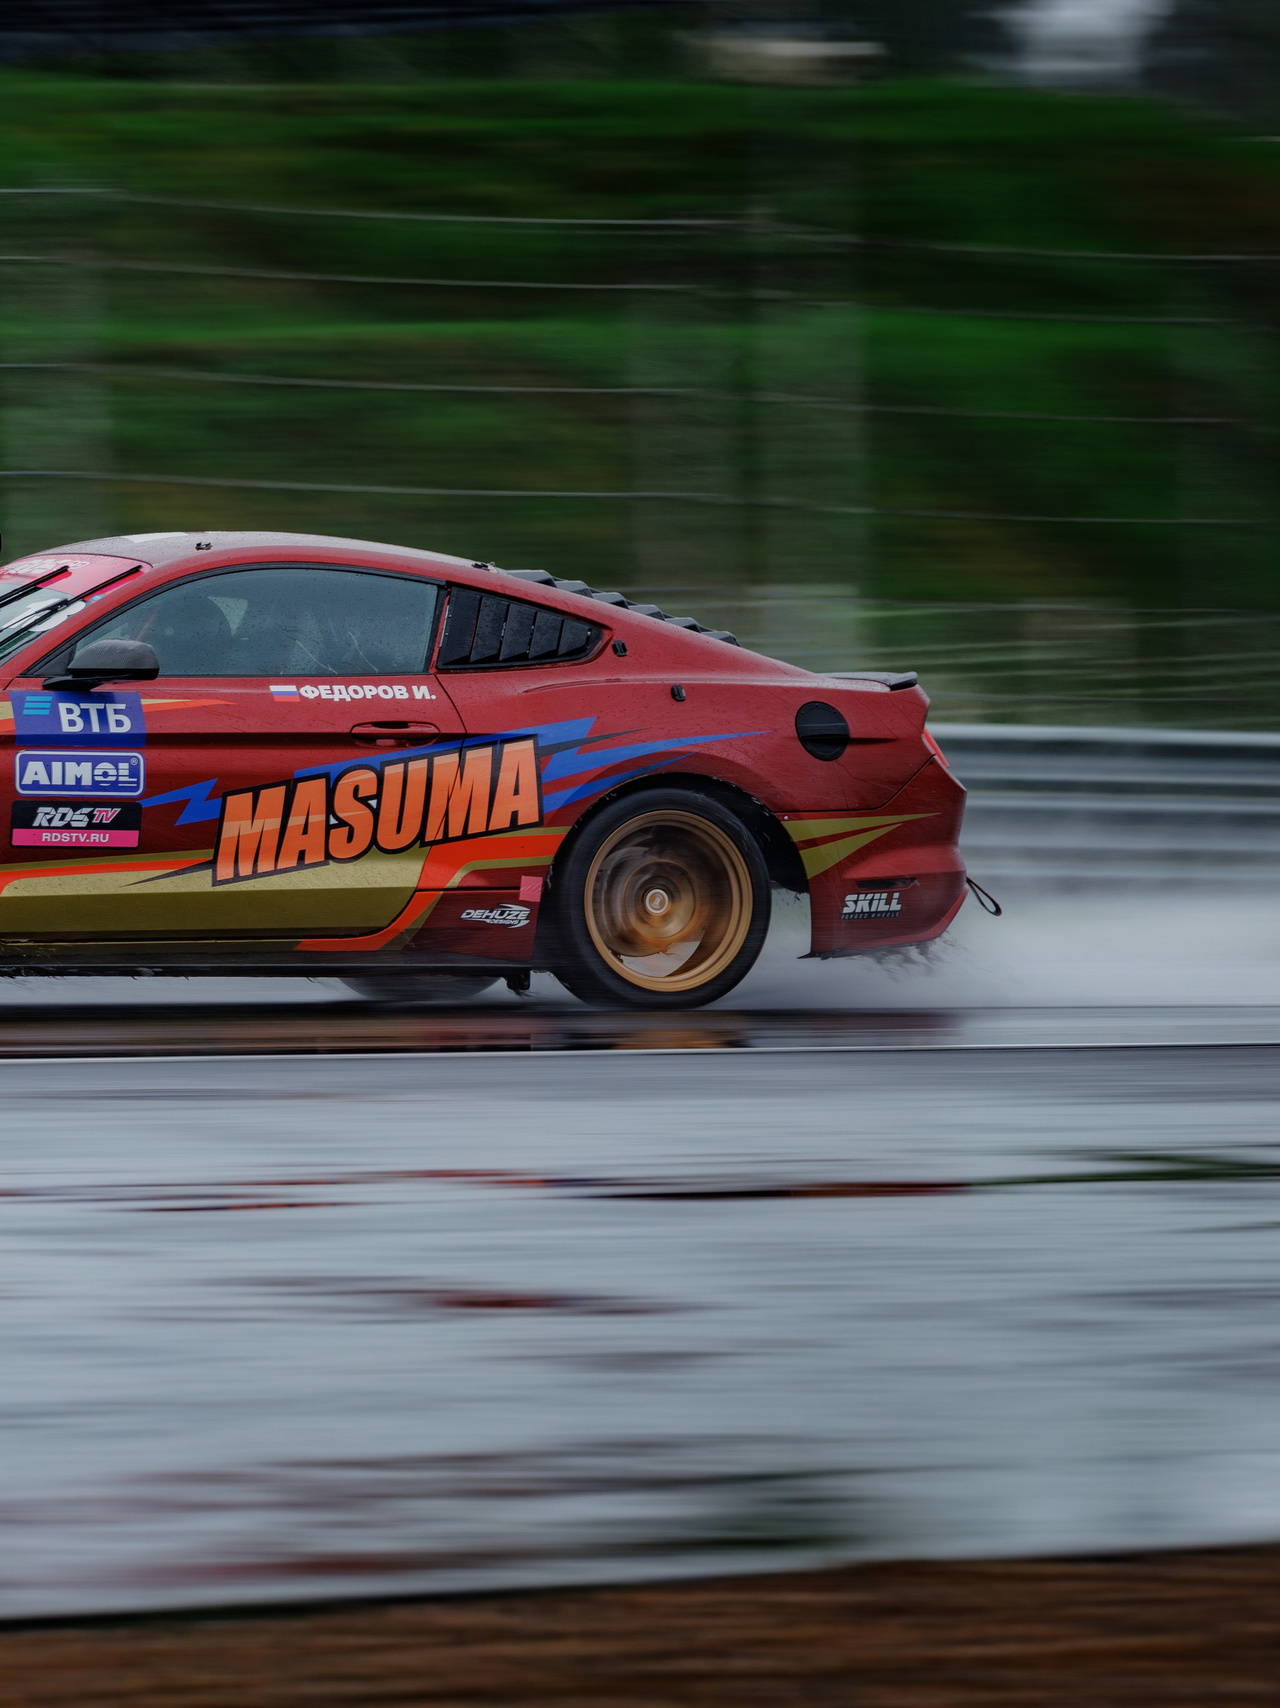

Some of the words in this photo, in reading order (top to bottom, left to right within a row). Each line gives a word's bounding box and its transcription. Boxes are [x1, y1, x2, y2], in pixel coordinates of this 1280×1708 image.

[299, 685, 409, 702] ФЕДОРОВ
[412, 685, 437, 700] И.
[58, 702, 132, 733] ВТБ
[21, 761, 138, 787] AIMOL
[32, 806, 94, 828] RDS
[92, 807, 122, 824] TV
[215, 738, 540, 882] MASUMA
[42, 832, 110, 843] RDSTV.RU
[842, 892, 902, 914] SKILL
[460, 909, 531, 920] DEHUZE
